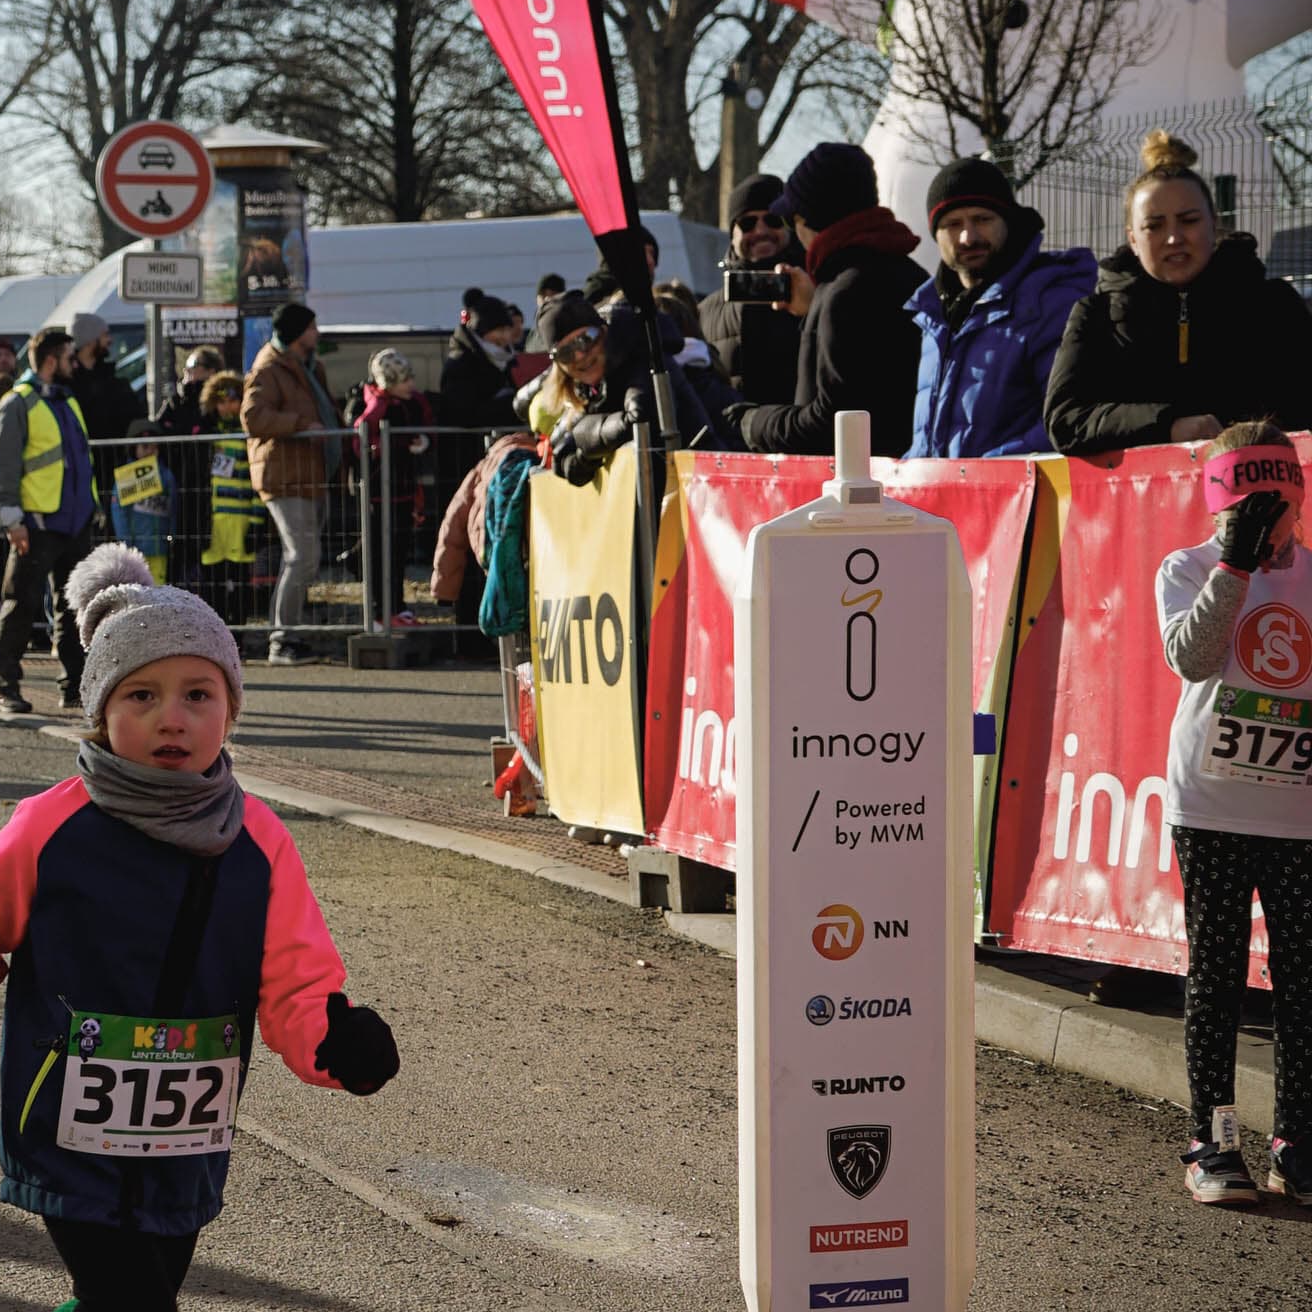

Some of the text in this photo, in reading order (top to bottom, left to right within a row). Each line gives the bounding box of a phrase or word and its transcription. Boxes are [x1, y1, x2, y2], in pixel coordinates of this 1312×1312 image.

[792, 726, 925, 763] innogy
[1211, 718, 1312, 771] 3179
[835, 796, 925, 819] Powered
[835, 823, 924, 849] by MVM
[874, 920, 909, 939] NN
[839, 996, 912, 1020] ŠKODA
[73, 1063, 224, 1128] 3152
[830, 1075, 906, 1095] RUNTO
[833, 1131, 885, 1142] PEUGEOT
[815, 1226, 904, 1247] NUTREND
